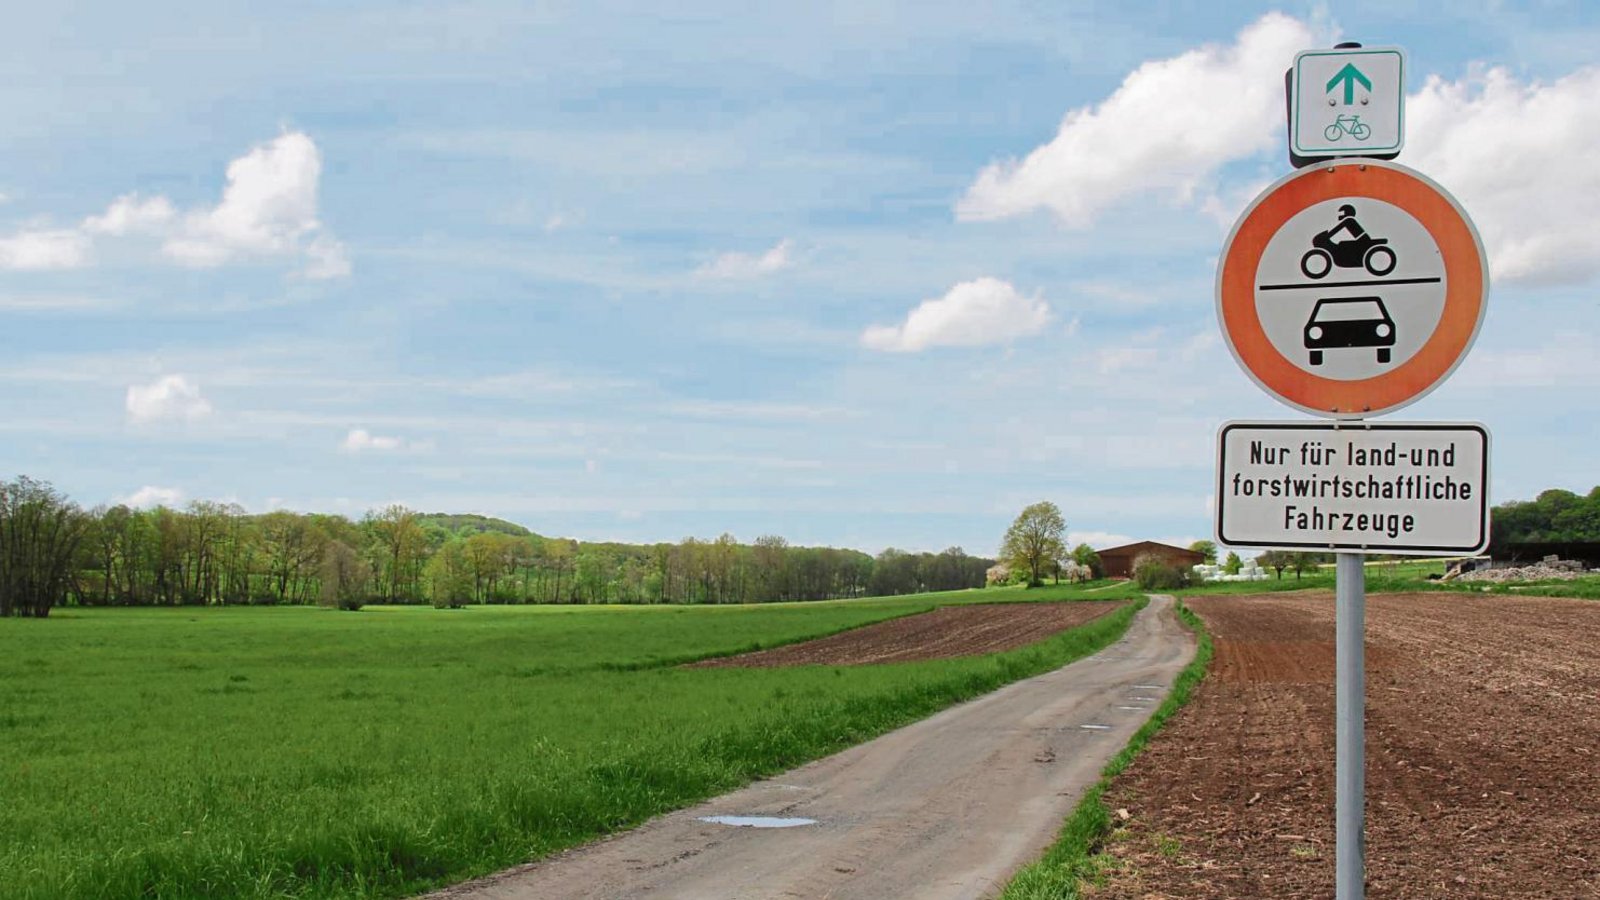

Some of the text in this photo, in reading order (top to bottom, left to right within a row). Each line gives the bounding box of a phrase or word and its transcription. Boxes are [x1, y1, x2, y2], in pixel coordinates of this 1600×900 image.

[1250, 440, 1291, 466] Nur
[1300, 441, 1337, 466] für
[1232, 472, 1472, 501] forstwirtschaftliche
[1284, 505, 1414, 537] Fahrzeuge
